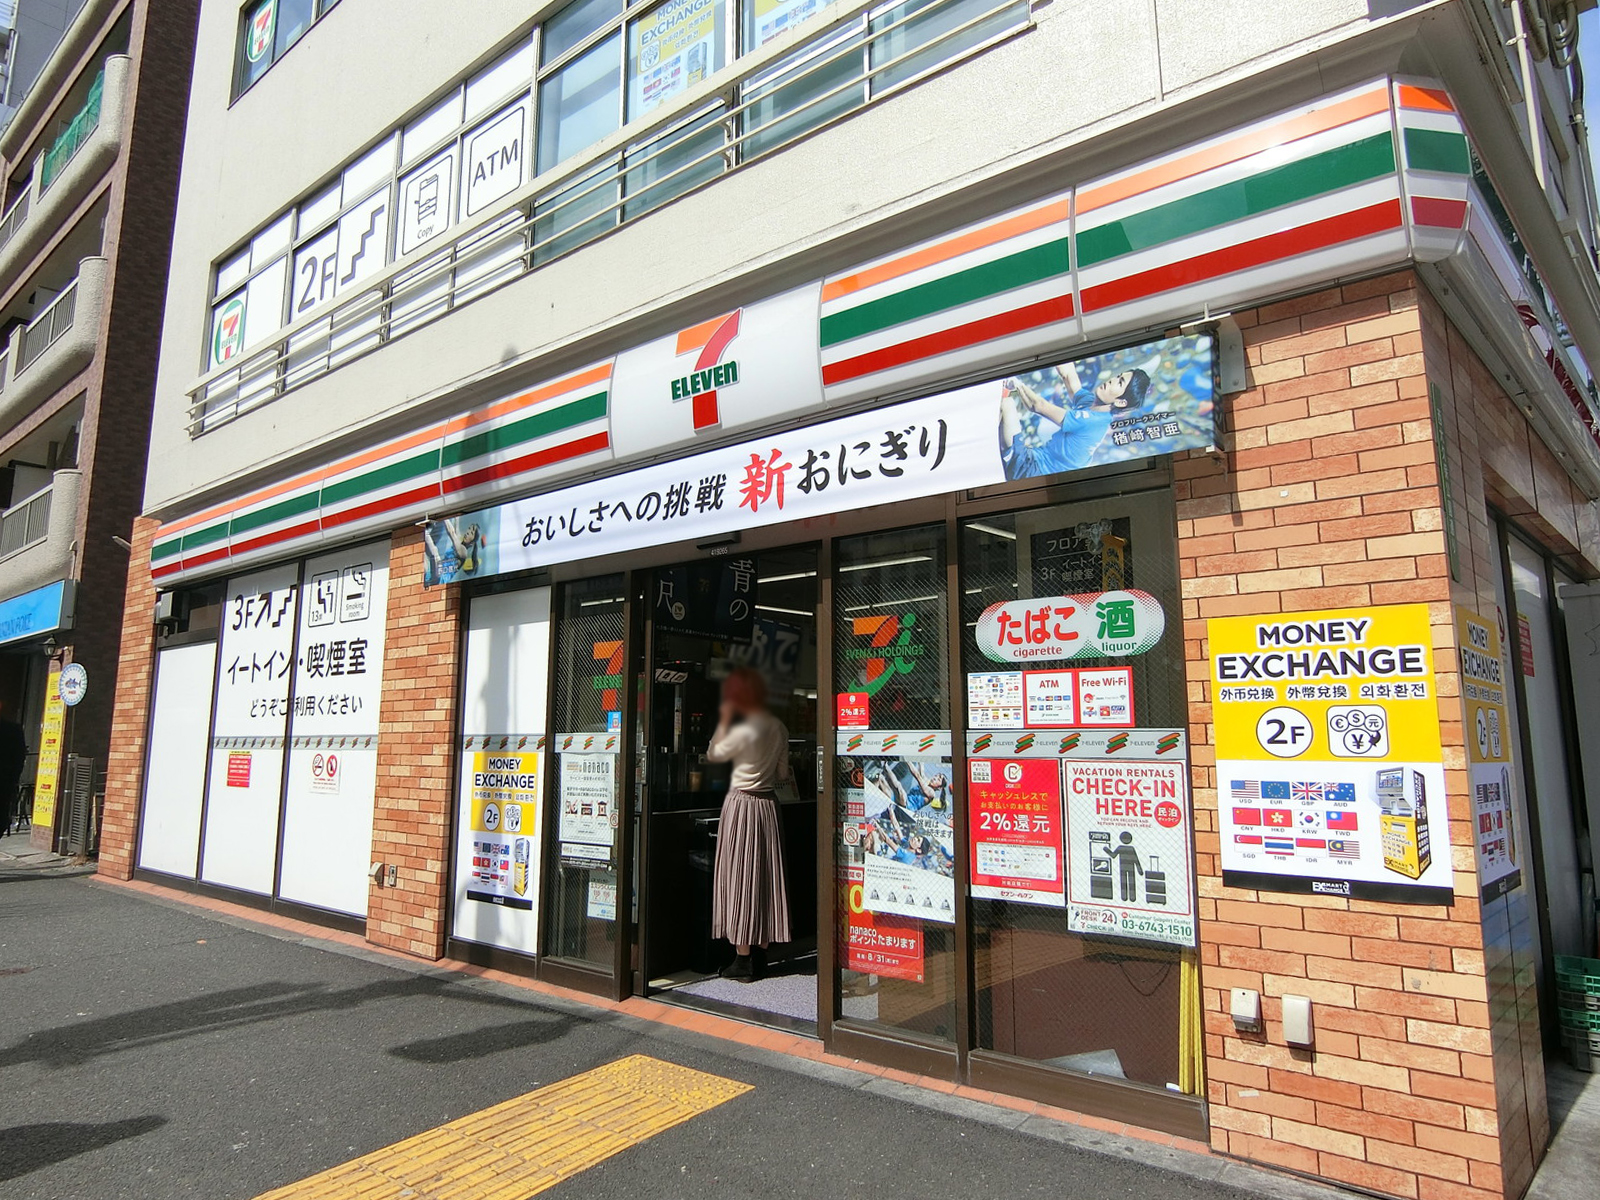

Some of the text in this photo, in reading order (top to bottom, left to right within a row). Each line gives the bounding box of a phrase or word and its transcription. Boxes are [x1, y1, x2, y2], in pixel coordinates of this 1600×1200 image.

[473, 138, 518, 188] ATM
[417, 224, 434, 240] Copy
[297, 253, 337, 313] 2F
[1111, 411, 1176, 429] プロフリークライマー
[522, 473, 727, 548] おいしさへの挑戦
[1041, 567, 1056, 580] 3F
[232, 594, 254, 631] 3F
[345, 602, 364, 611] Smoking
[997, 600, 1135, 646] たばこ 酒
[1259, 620, 1368, 645] MONEY
[878, 645, 924, 657] HOLDINGS
[1013, 641, 1137, 658] cigarette liquor
[1218, 648, 1423, 679] EXCHANGE
[1463, 648, 1500, 684] EXCHANGE
[1039, 679, 1060, 689] ATM
[1081, 676, 1127, 687] Free Wi-Fi
[1361, 683, 1426, 698] 외화환전
[1266, 718, 1305, 745] 2F
[488, 759, 522, 770] MONEY
[1072, 767, 1175, 778] VACATION RENTALS
[474, 774, 535, 789] EXCHANGE
[1072, 777, 1176, 798] CHECK-IN
[980, 790, 1049, 801] キャッシュレスで
[980, 801, 1049, 811] お支払いのお客様に
[1096, 798, 1152, 817] HERE
[1158, 807, 1178, 817] 民泊
[486, 809, 498, 824] 2F
[980, 812, 1050, 833] 2%還元
[1101, 912, 1114, 923] 24
[849, 925, 877, 937] nanaco
[1121, 919, 1192, 936] 03-6743-1510
